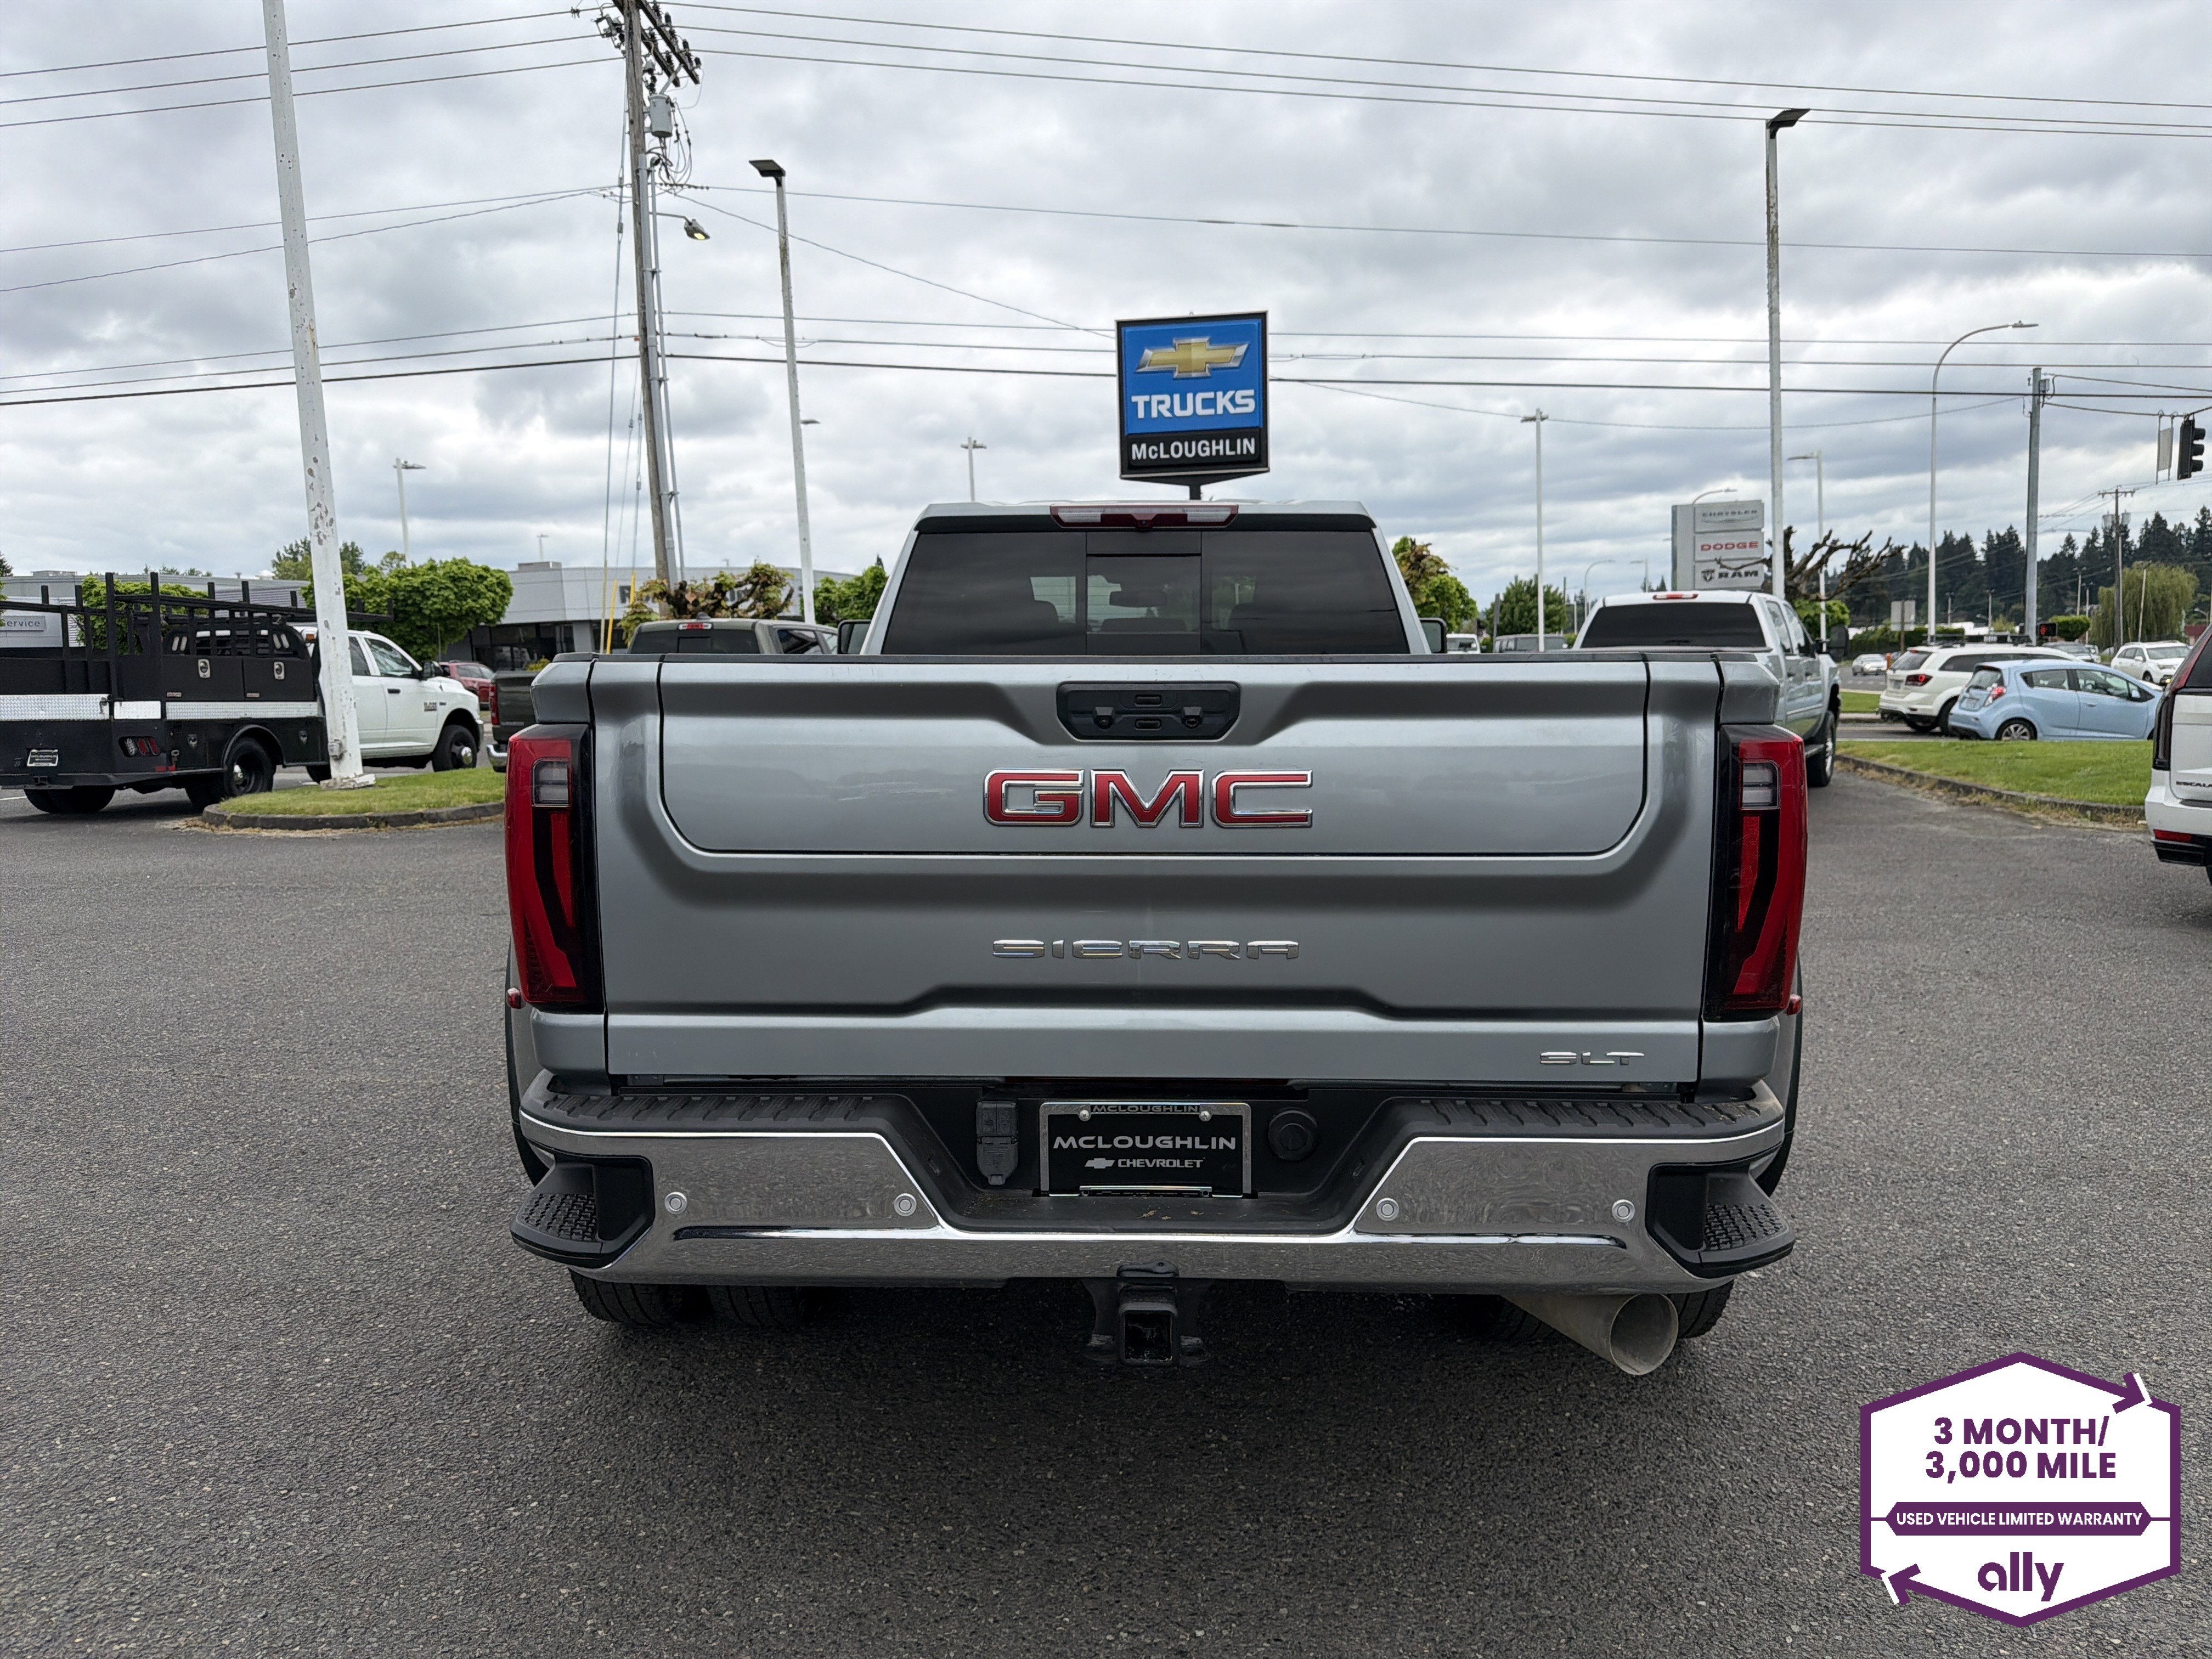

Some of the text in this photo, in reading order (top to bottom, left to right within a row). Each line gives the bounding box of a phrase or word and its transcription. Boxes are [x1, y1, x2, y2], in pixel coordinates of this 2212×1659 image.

[1131, 389, 1255, 419] TRUCKS
[1132, 437, 1255, 460] McLOUGHLIN
[1701, 541, 1758, 551] DODGE
[1718, 570, 1758, 578] RAM
[983, 769, 1312, 828] GMC
[992, 939, 1299, 959] SIERRA
[1540, 1052, 1644, 1065] SLT
[1053, 1136, 1237, 1150] MCLOUGHLIN
[1118, 1159, 1204, 1168] CHEVROLET
